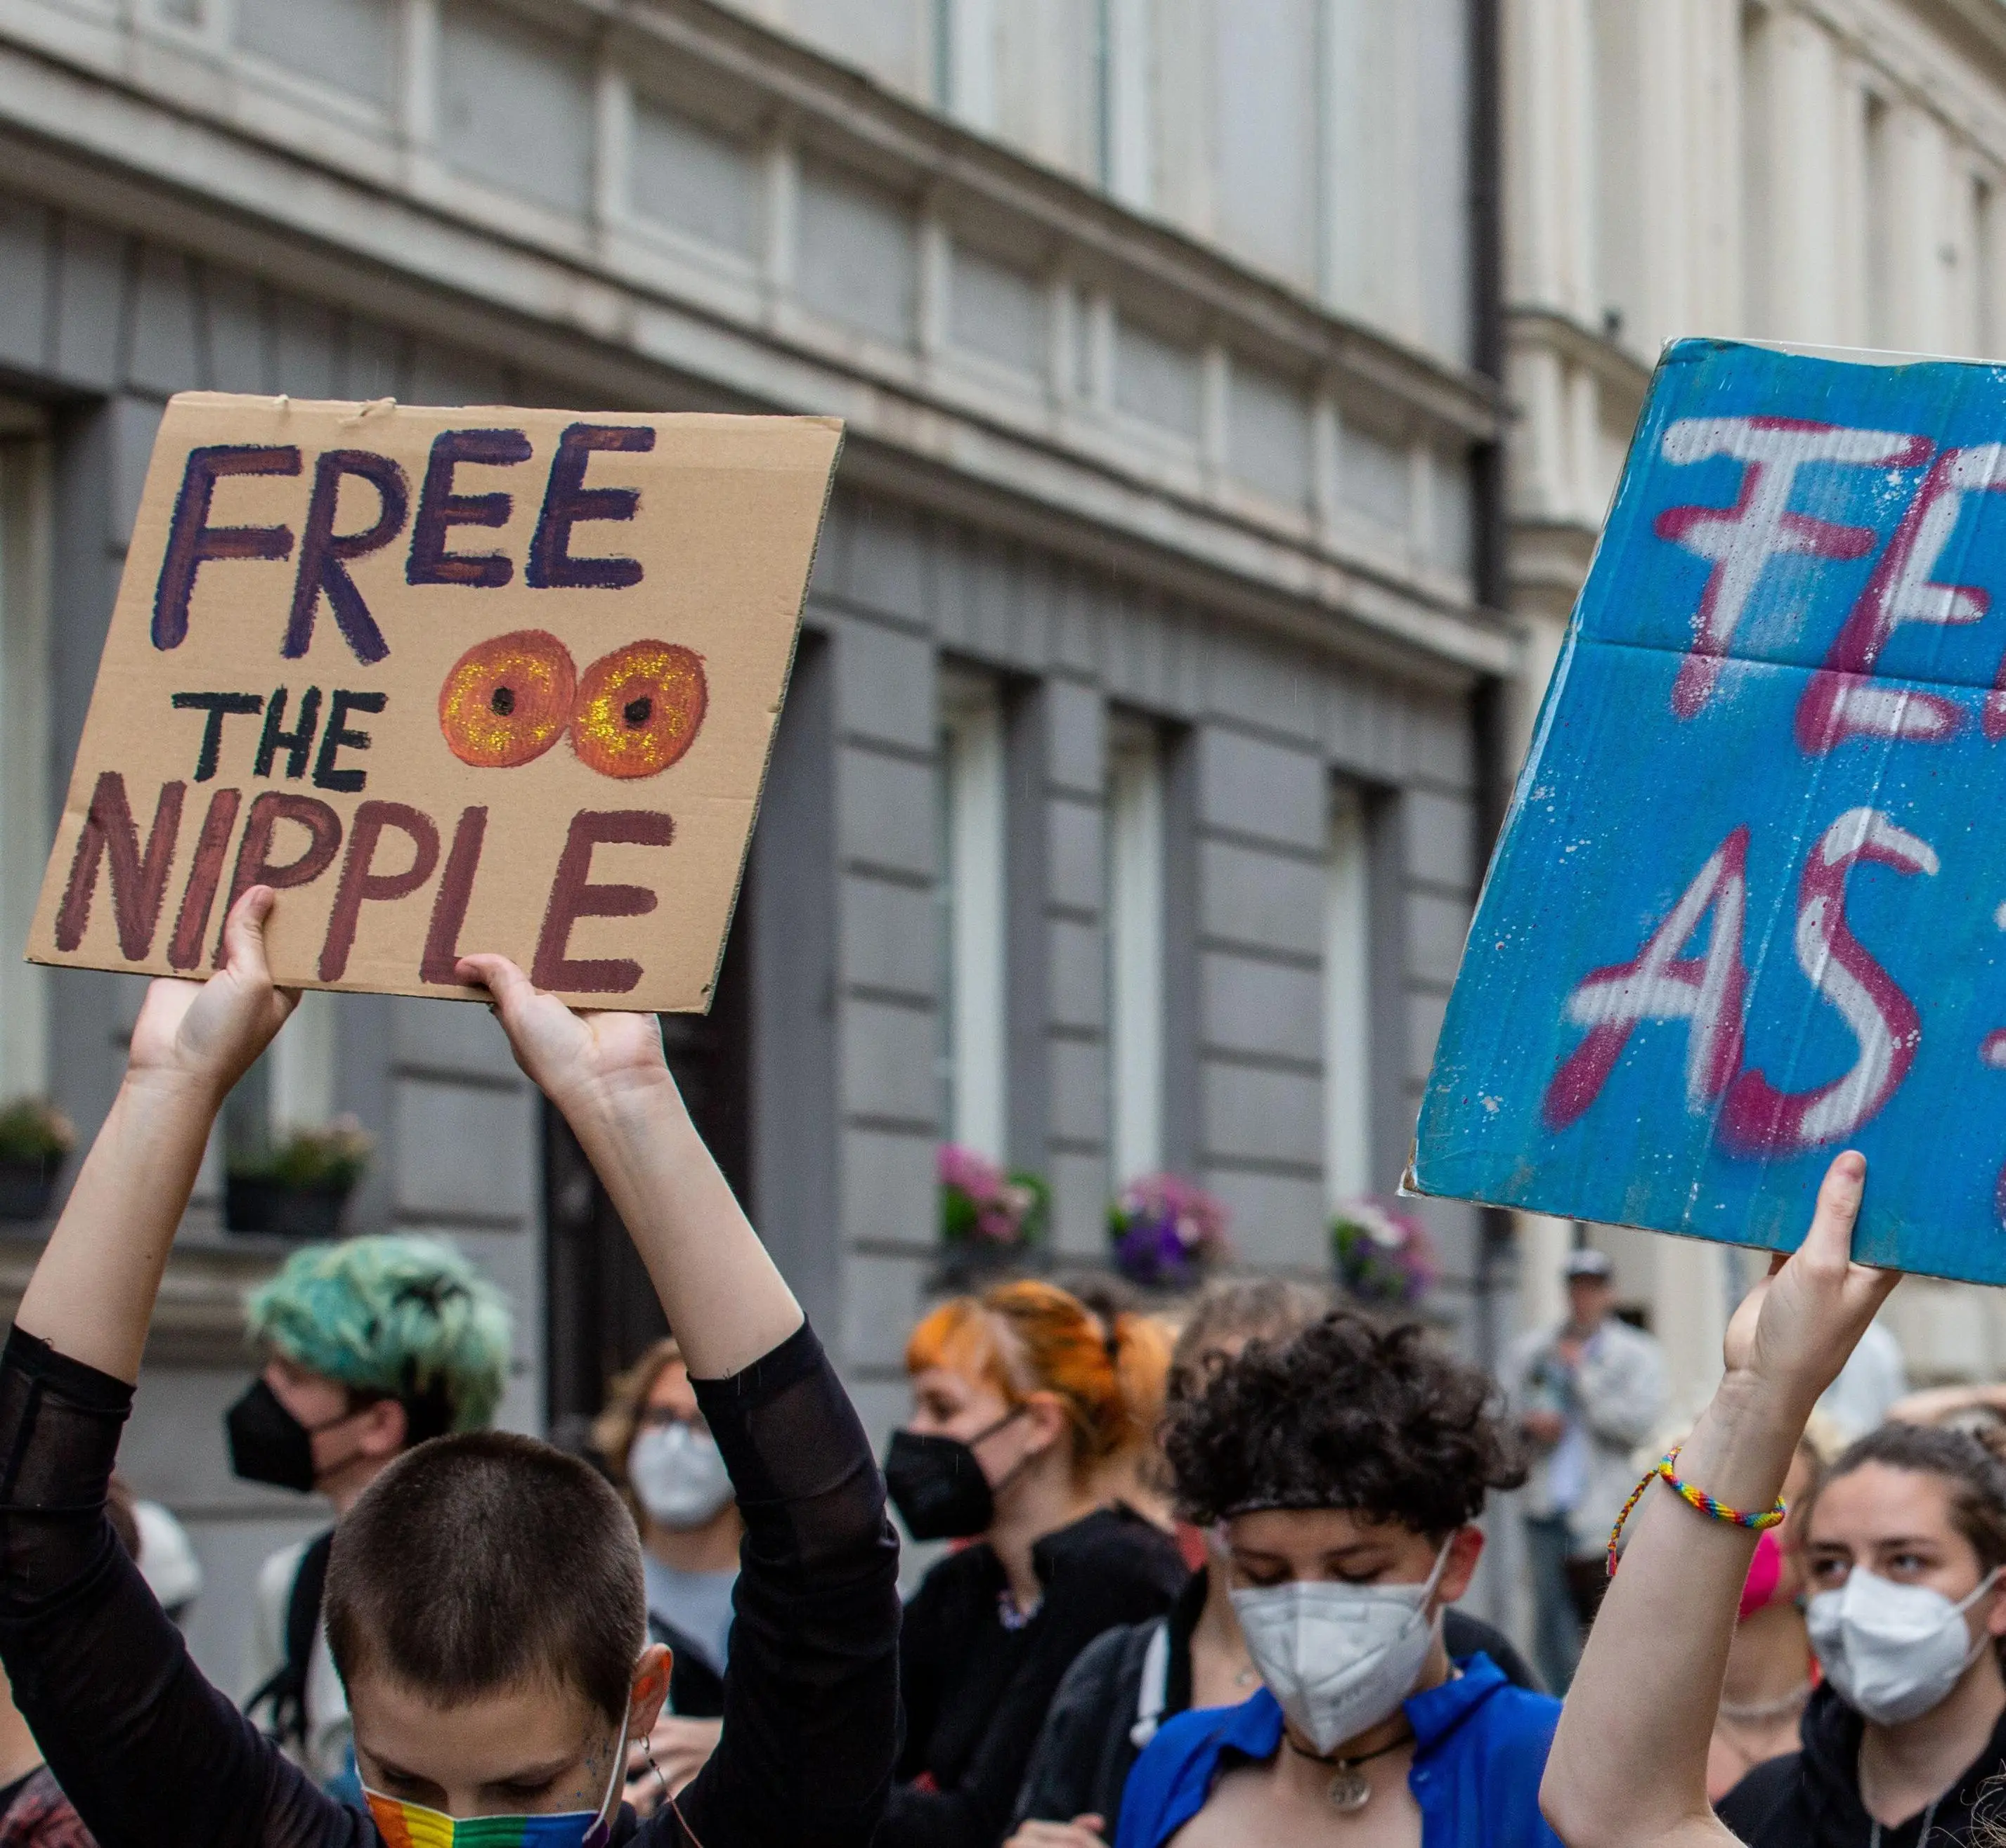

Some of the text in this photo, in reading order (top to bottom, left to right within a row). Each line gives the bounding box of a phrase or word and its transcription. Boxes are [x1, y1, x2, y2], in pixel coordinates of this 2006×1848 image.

[150, 423, 657, 665] FREE
[1654, 415, 2006, 757] FE
[171, 684, 389, 792] THE
[53, 770, 677, 993] NIPPLE
[1542, 807, 1940, 1161] AS
